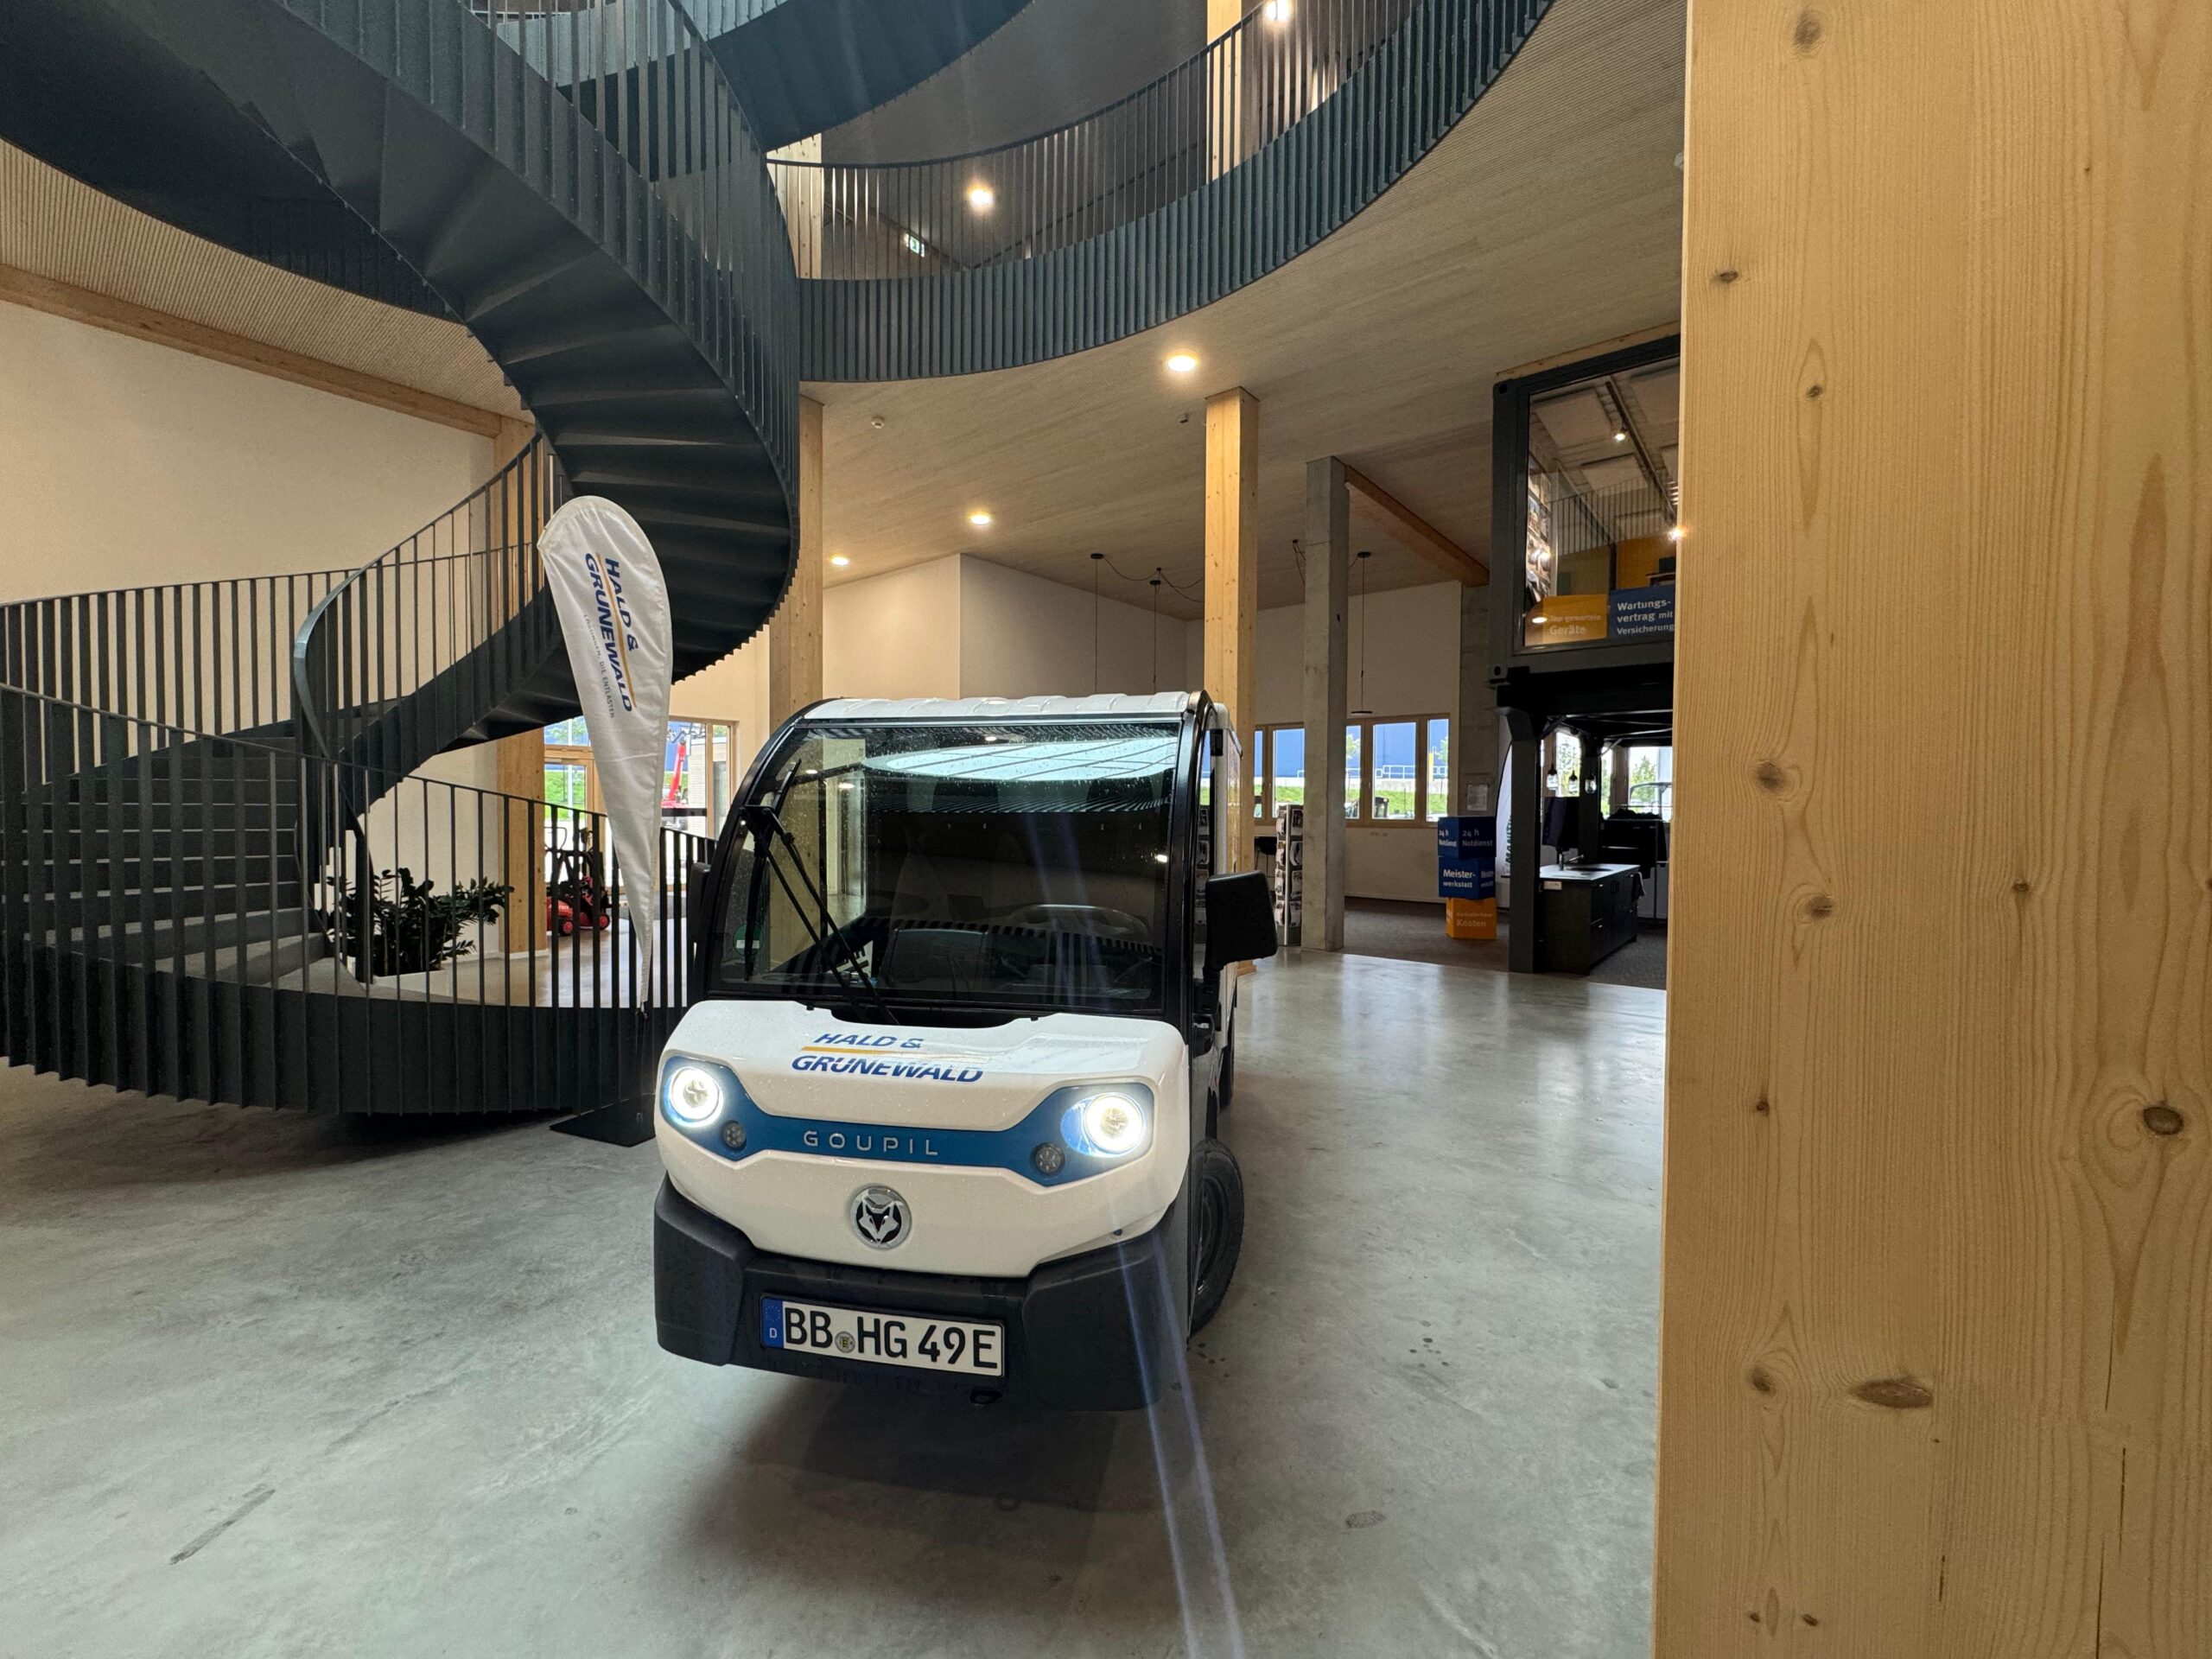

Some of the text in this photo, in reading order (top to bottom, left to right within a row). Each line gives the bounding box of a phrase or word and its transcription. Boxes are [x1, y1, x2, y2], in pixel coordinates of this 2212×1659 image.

[605, 557, 639, 652] HALD &
[1617, 599, 1671, 611] Wartungs-
[1617, 611, 1674, 623] vertrag mit
[1549, 625, 1586, 636] Geräte
[602, 677, 614, 718] ENTLASTEN
[1474, 828, 1479, 836] h
[1443, 868, 1477, 879] Meister-
[814, 1033, 925, 1049] HALD &
[804, 1130, 938, 1156] GOUPIL
[769, 1327, 778, 1338] D
[785, 1307, 998, 1370] BB HG 49E
